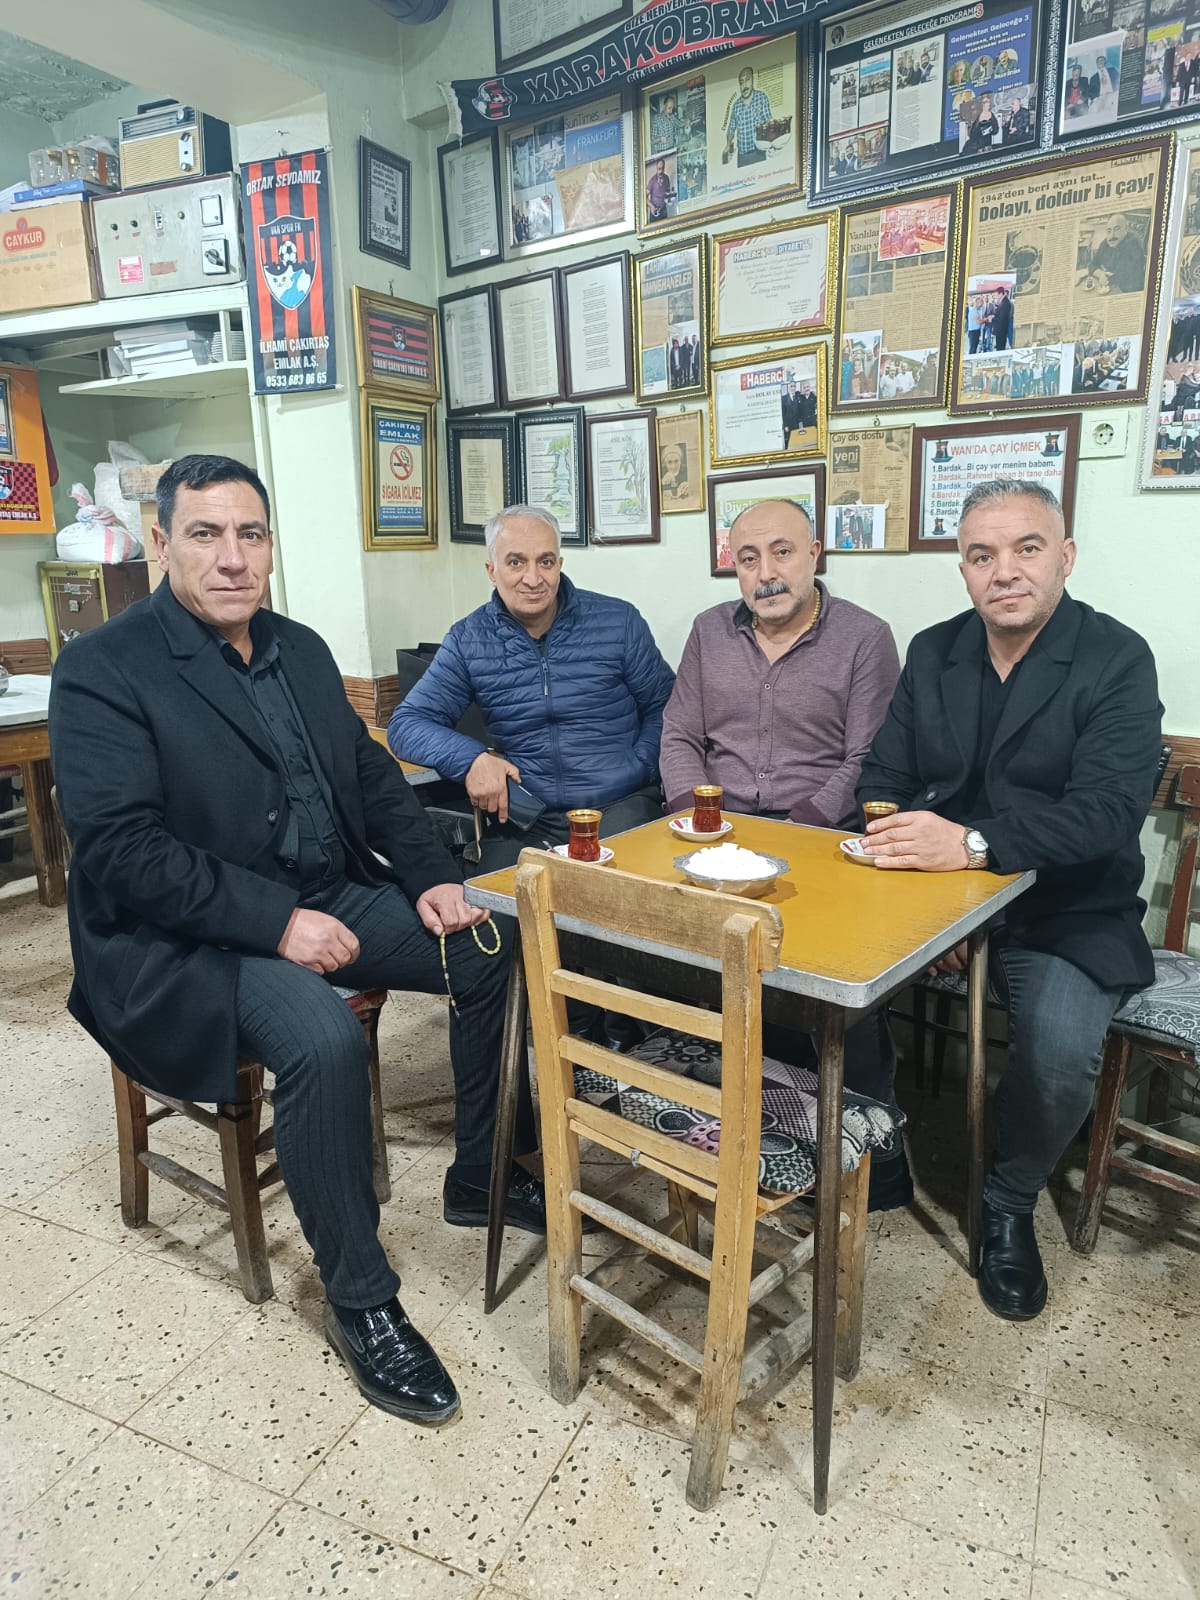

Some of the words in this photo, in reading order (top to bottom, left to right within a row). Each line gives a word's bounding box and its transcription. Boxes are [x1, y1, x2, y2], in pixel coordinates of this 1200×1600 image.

[577, 126, 619, 148] FRANKFURT
[246, 175, 274, 196] ORTAK
[275, 169, 321, 188] SEVDAMIZ
[1028, 183, 1050, 193] beri
[1053, 178, 1077, 190] aynı
[979, 200, 1032, 222] Dolayı,
[1035, 186, 1092, 211] doldur
[1095, 180, 1112, 199] bi
[1115, 172, 1154, 198] çay!
[271, 226, 280, 235] VAN
[281, 224, 294, 234] SPOR
[260, 338, 288, 354] İLHAMİ
[273, 356, 302, 370] EMLAK
[266, 375, 287, 388] 0533
[305, 373, 315, 384] 06
[317, 371, 327, 384] 65
[380, 430, 420, 440] EMLAK
[861, 431, 885, 441] dostu
[834, 448, 859, 464] yeni
[951, 444, 988, 456] WAN'DA
[989, 442, 1009, 456] ÇAY
[1010, 440, 1041, 453] İÇMEK
